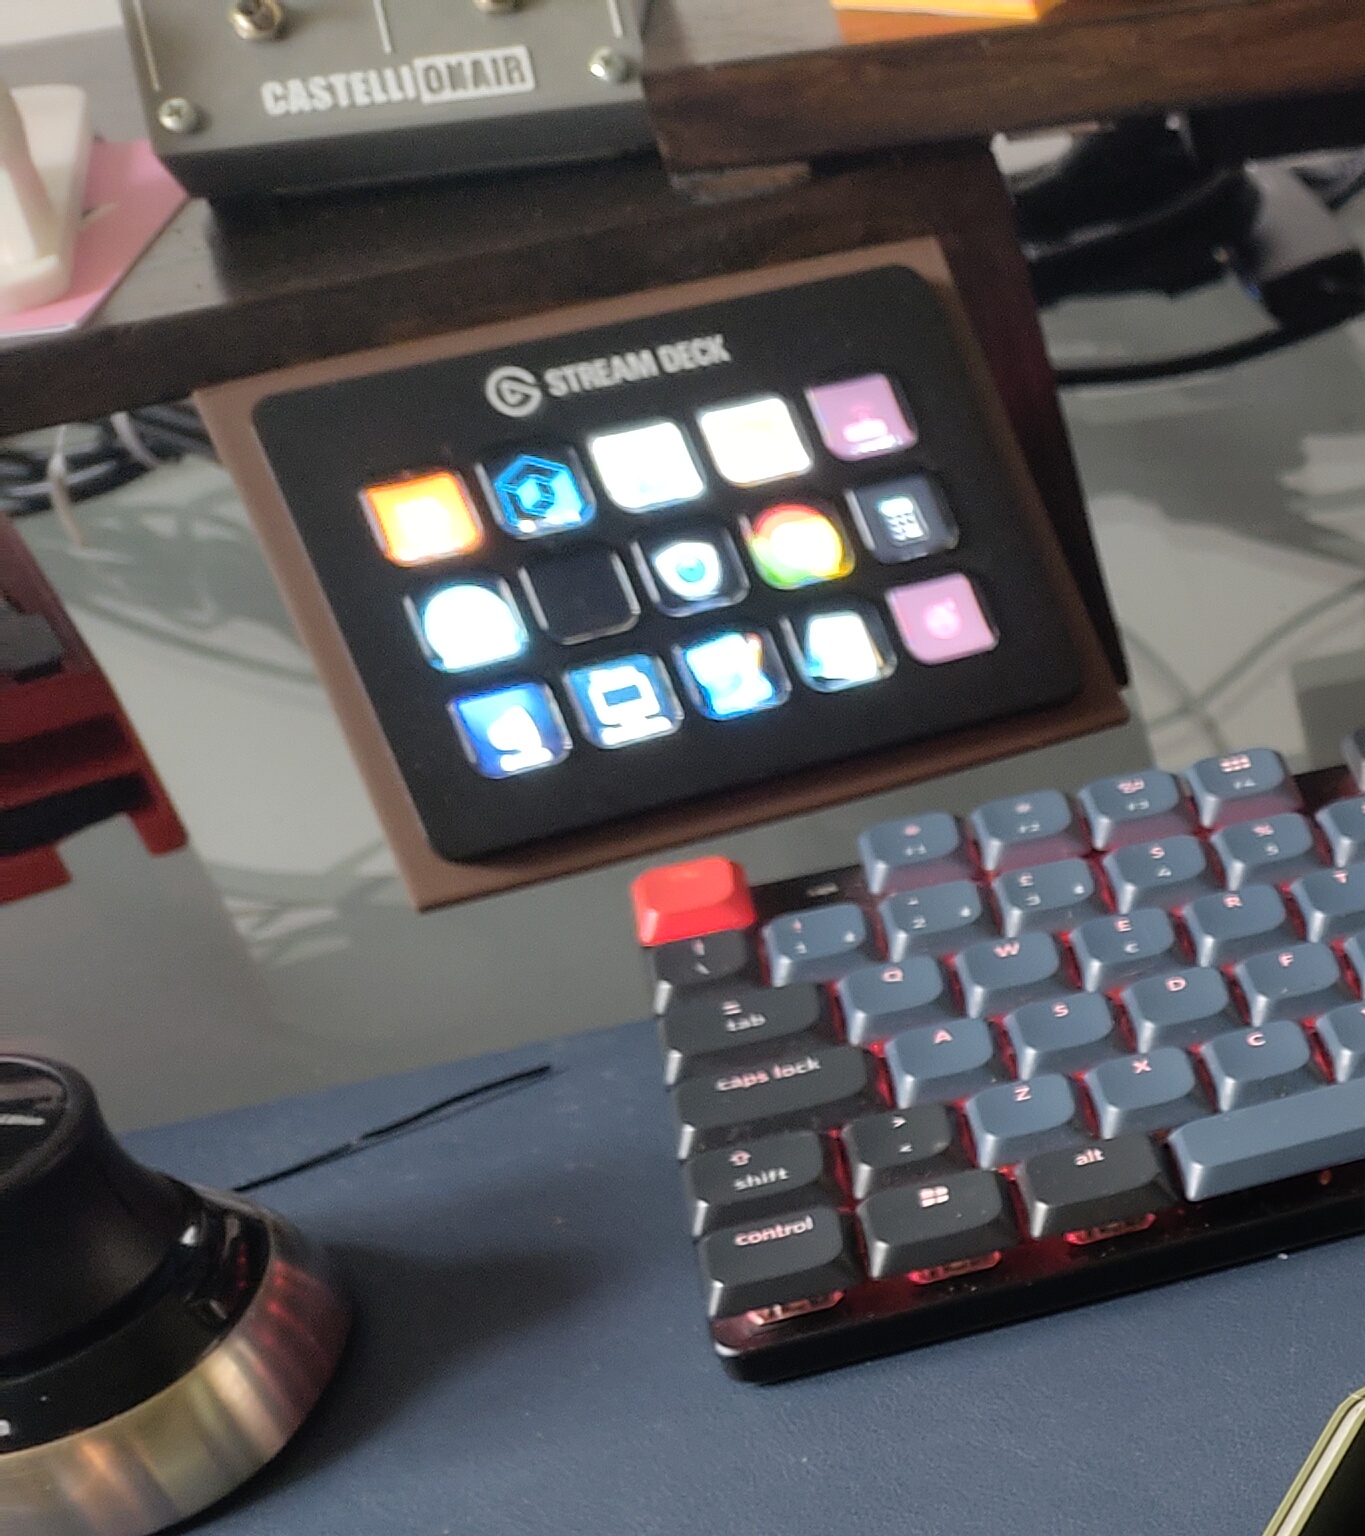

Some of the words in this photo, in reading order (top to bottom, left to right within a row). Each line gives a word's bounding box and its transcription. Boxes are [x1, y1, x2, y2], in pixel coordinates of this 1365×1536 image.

[261, 65, 416, 116] CASTELLI
[544, 349, 659, 397] STREAM
[657, 334, 731, 373] DECK
[1116, 918, 1131, 932] E
[1165, 977, 1187, 991] D
[1053, 1002, 1069, 1017] S
[725, 1012, 766, 1033] tab
[934, 1029, 952, 1044] A
[1247, 1032, 1266, 1046] C
[716, 1067, 769, 1092] caps
[773, 1057, 821, 1079] lock
[1132, 1059, 1152, 1074] X
[1014, 1085, 1032, 1101] Z
[1074, 1148, 1104, 1166] alt
[734, 1168, 789, 1191] shift
[735, 1216, 813, 1247] control
